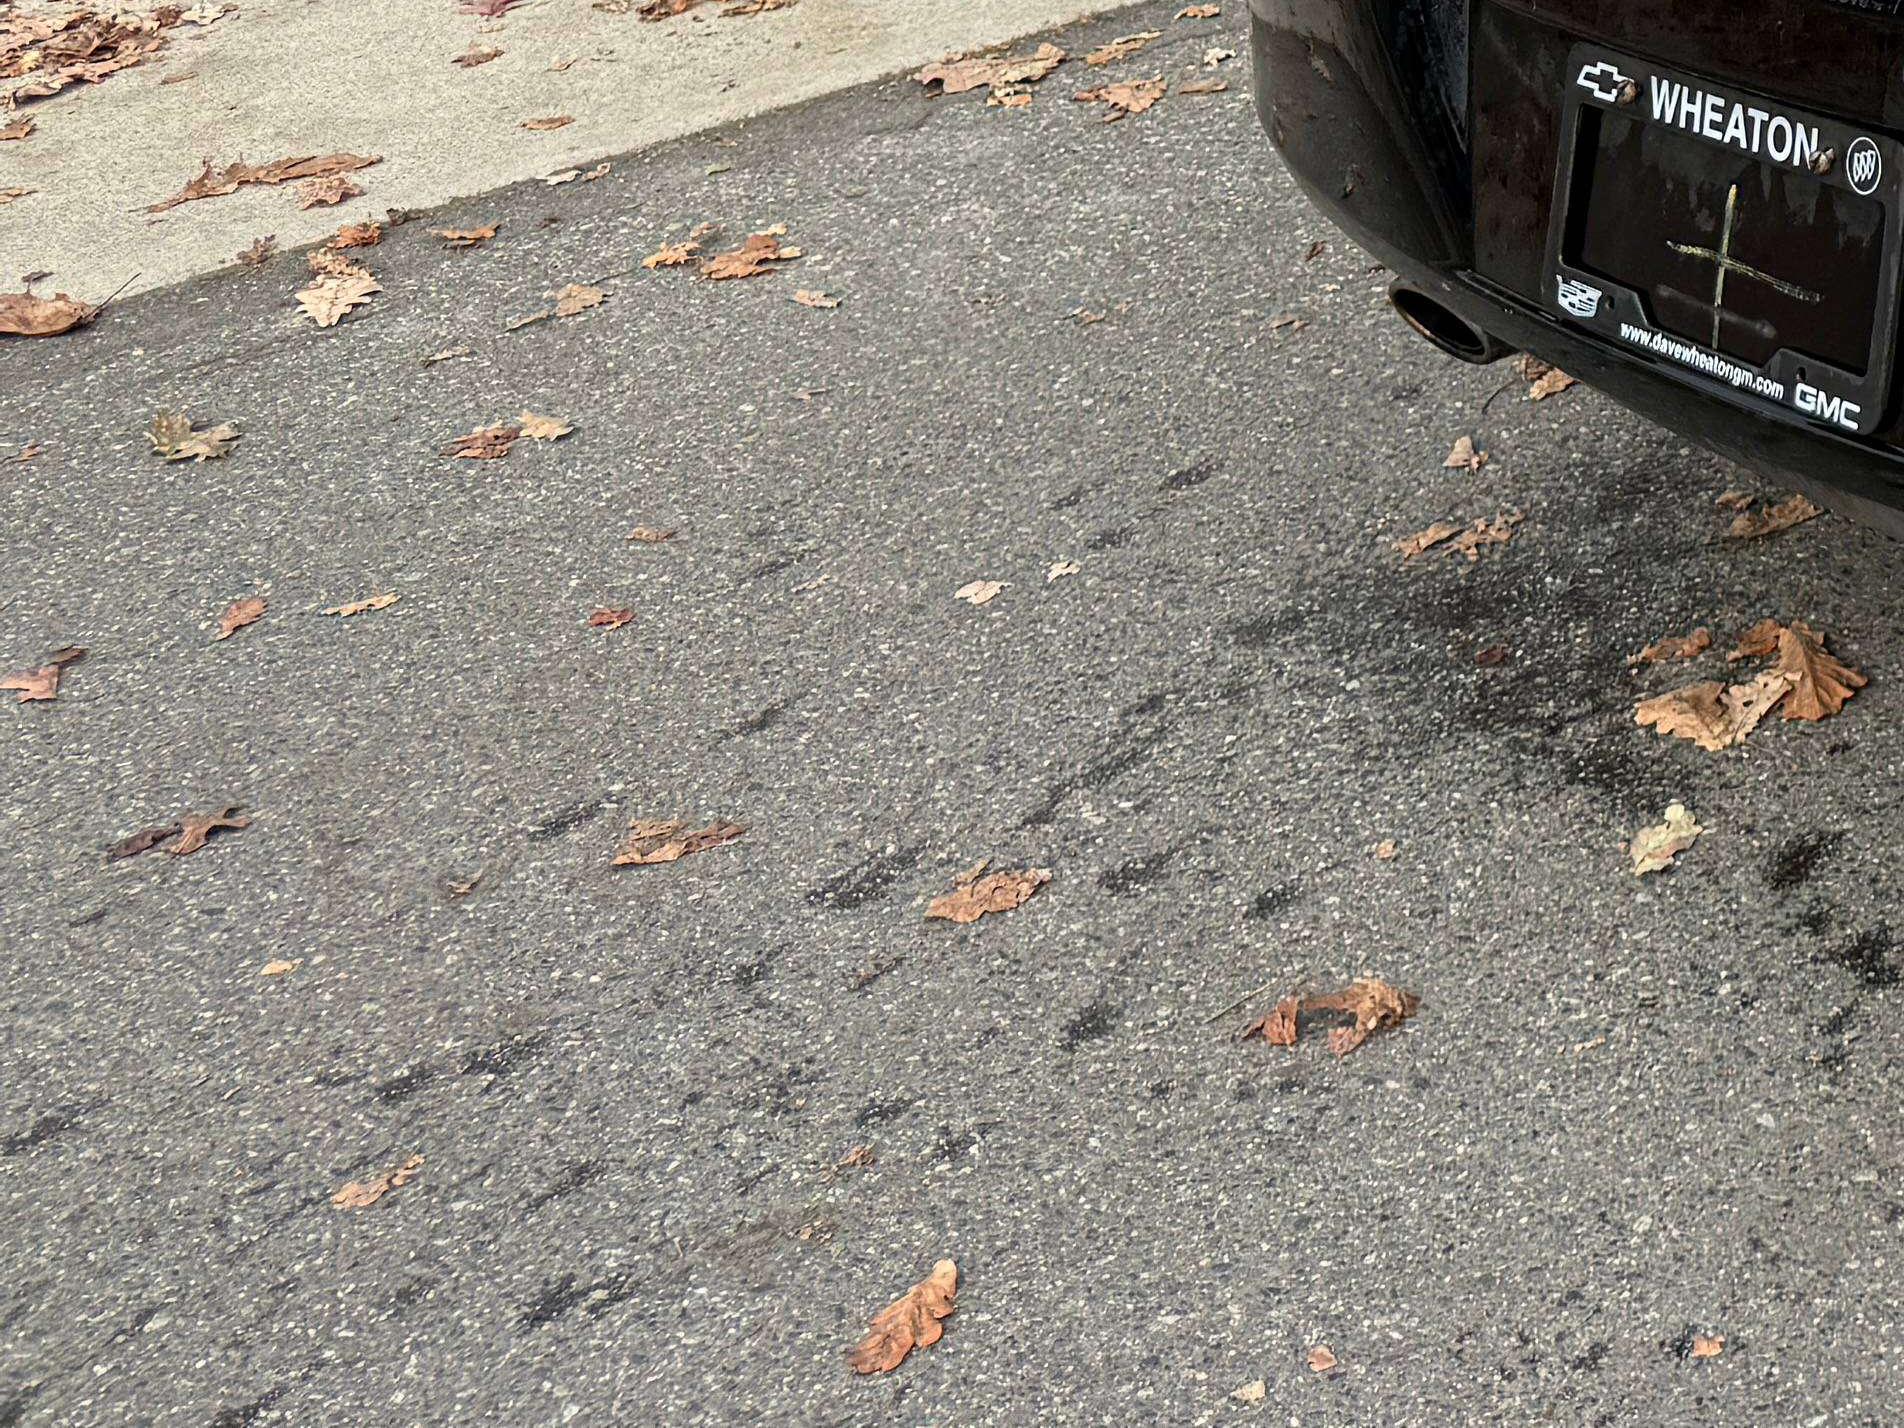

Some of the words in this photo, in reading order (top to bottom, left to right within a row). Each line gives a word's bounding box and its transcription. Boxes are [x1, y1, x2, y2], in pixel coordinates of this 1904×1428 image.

[1650, 75, 1821, 167] WHEATON
[1620, 322, 1784, 400] www.davewheatongm.com
[1794, 382, 1861, 431] GMC
